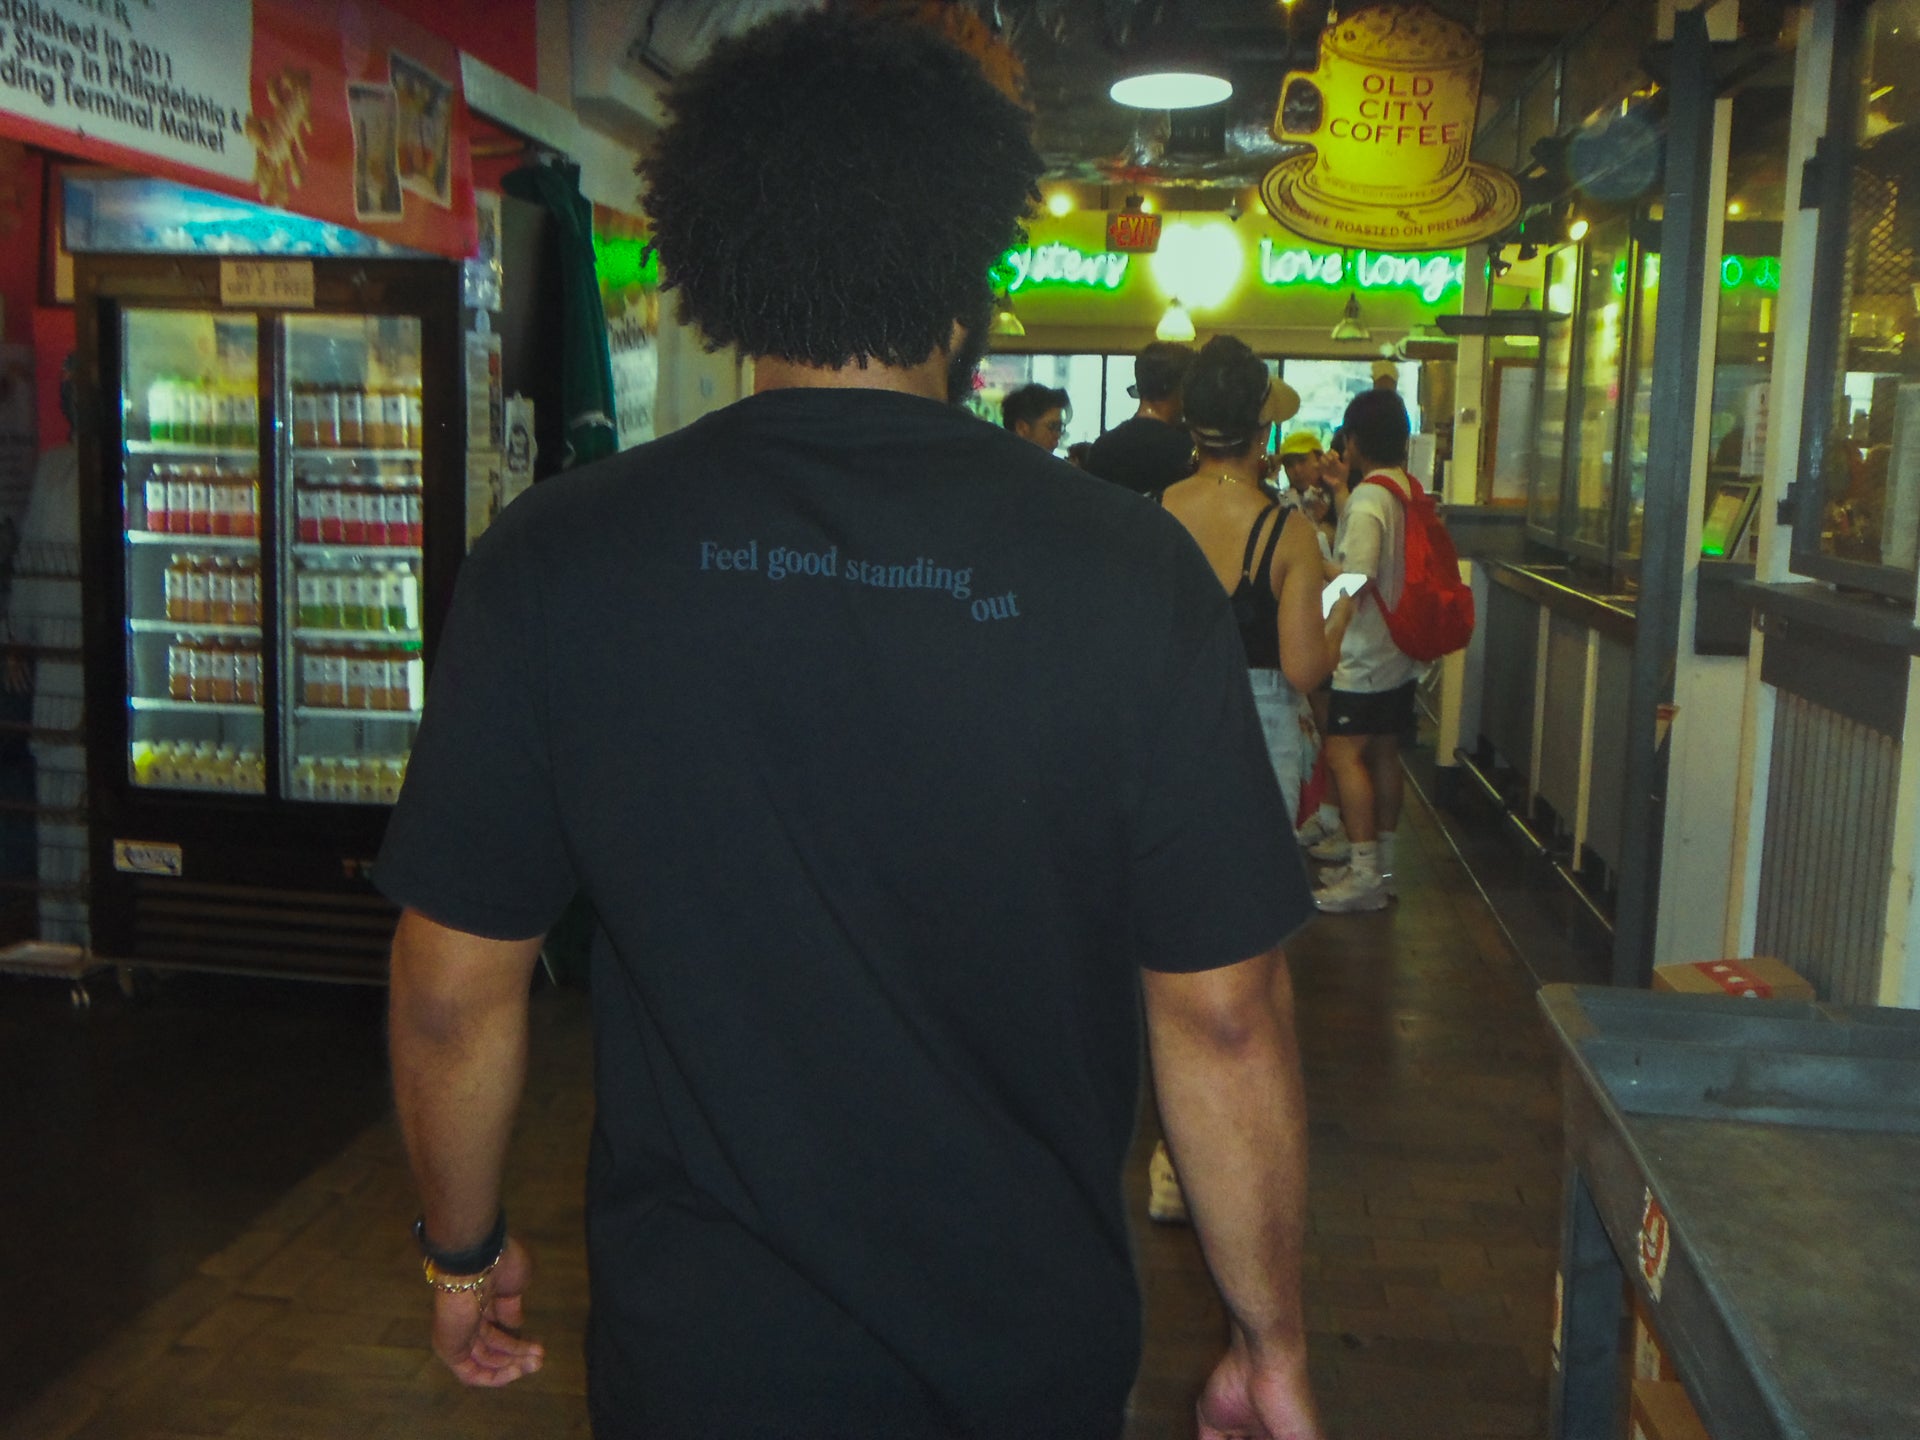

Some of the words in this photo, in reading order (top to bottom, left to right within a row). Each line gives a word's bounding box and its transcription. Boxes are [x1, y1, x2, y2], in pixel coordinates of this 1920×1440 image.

[128, 38, 172, 82] 2011
[13, 25, 76, 74] Store
[107, 59, 226, 131] Philadelphia
[231, 107, 243, 134] &
[1362, 73, 1435, 97] OLD
[61, 71, 154, 133] Terminal
[159, 108, 225, 155] Market
[1359, 97, 1434, 121] CITY
[1329, 117, 1461, 146] COFFEE
[1115, 213, 1158, 248] EXIT
[1335, 220, 1399, 238] ROASTED
[1403, 225, 1423, 238] ON
[1260, 239, 1343, 284] love
[700, 540, 759, 571] Feel
[767, 545, 838, 580] good
[845, 556, 973, 600] standing
[971, 590, 1020, 622] out
